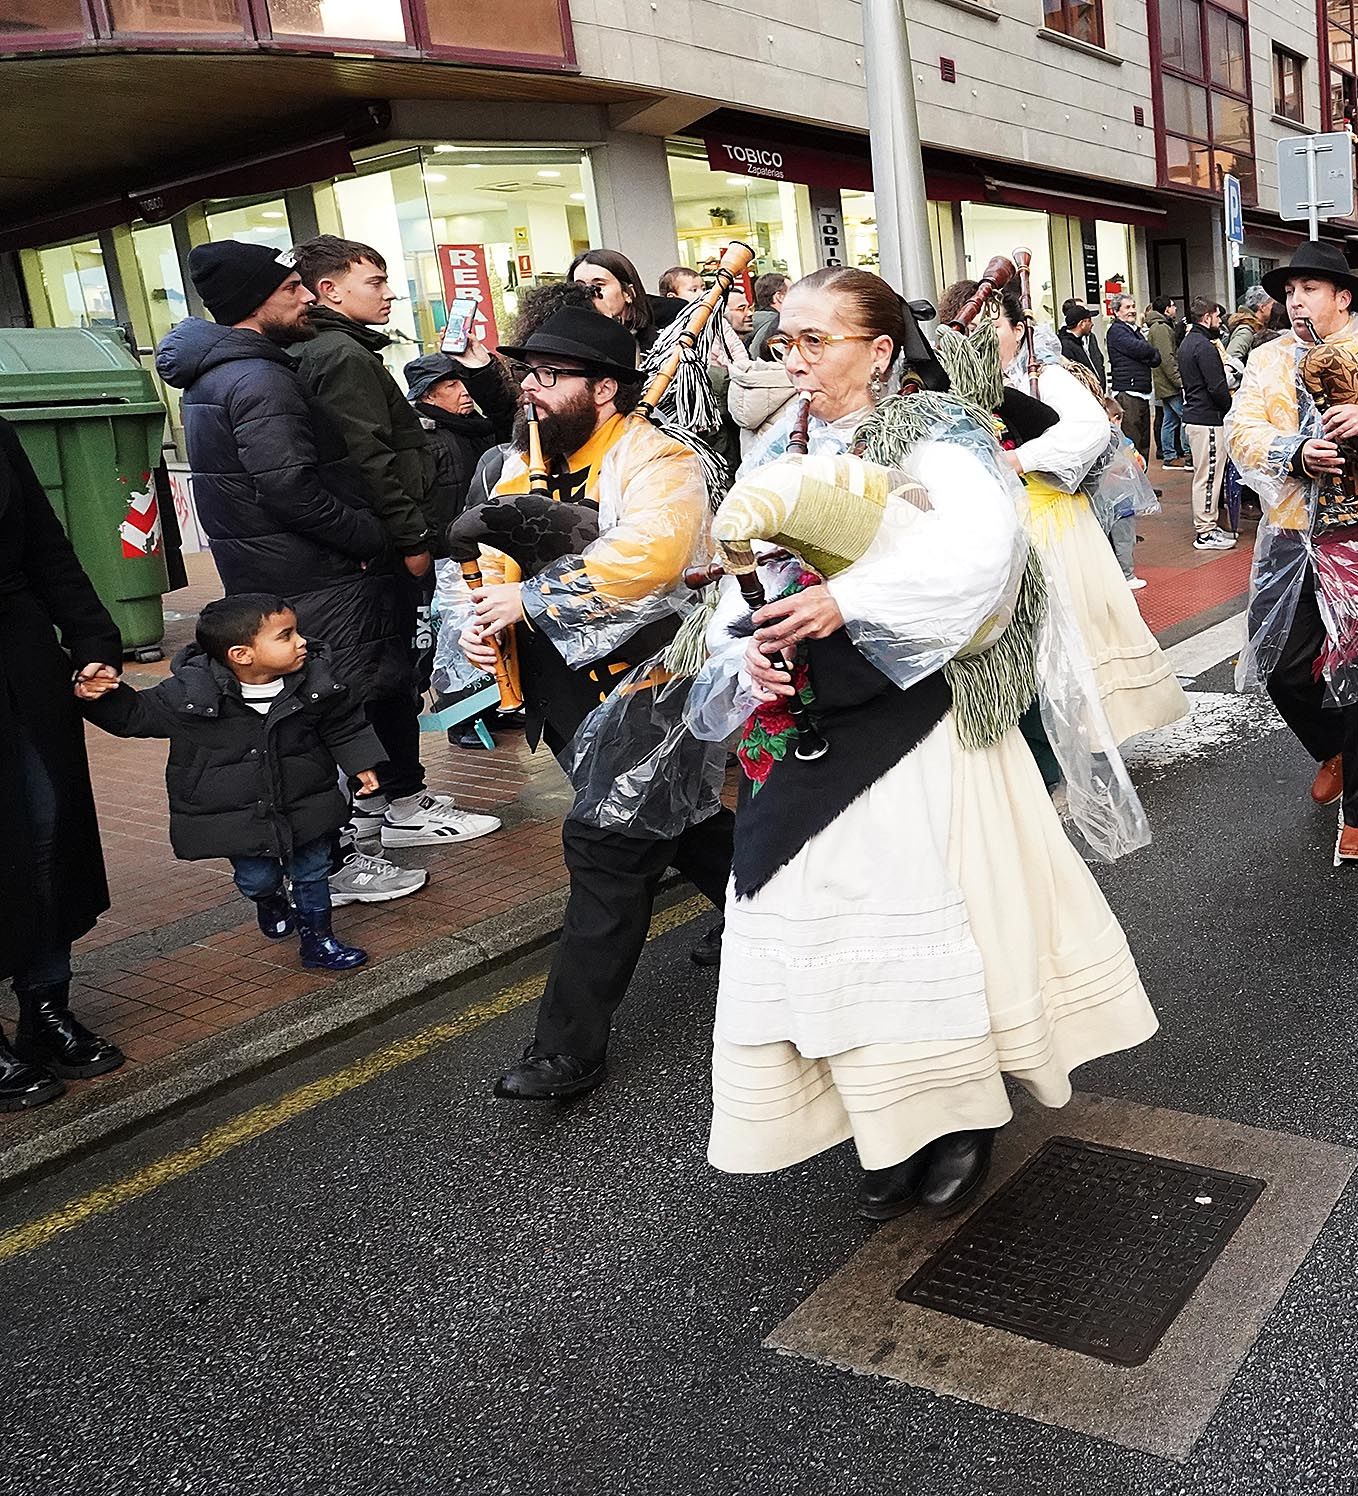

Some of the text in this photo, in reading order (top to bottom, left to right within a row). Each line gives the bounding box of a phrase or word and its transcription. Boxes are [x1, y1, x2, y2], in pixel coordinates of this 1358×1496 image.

[722, 144, 783, 168] TOBICO
[1231, 186, 1240, 235] P
[416, 605, 432, 649] PXG
